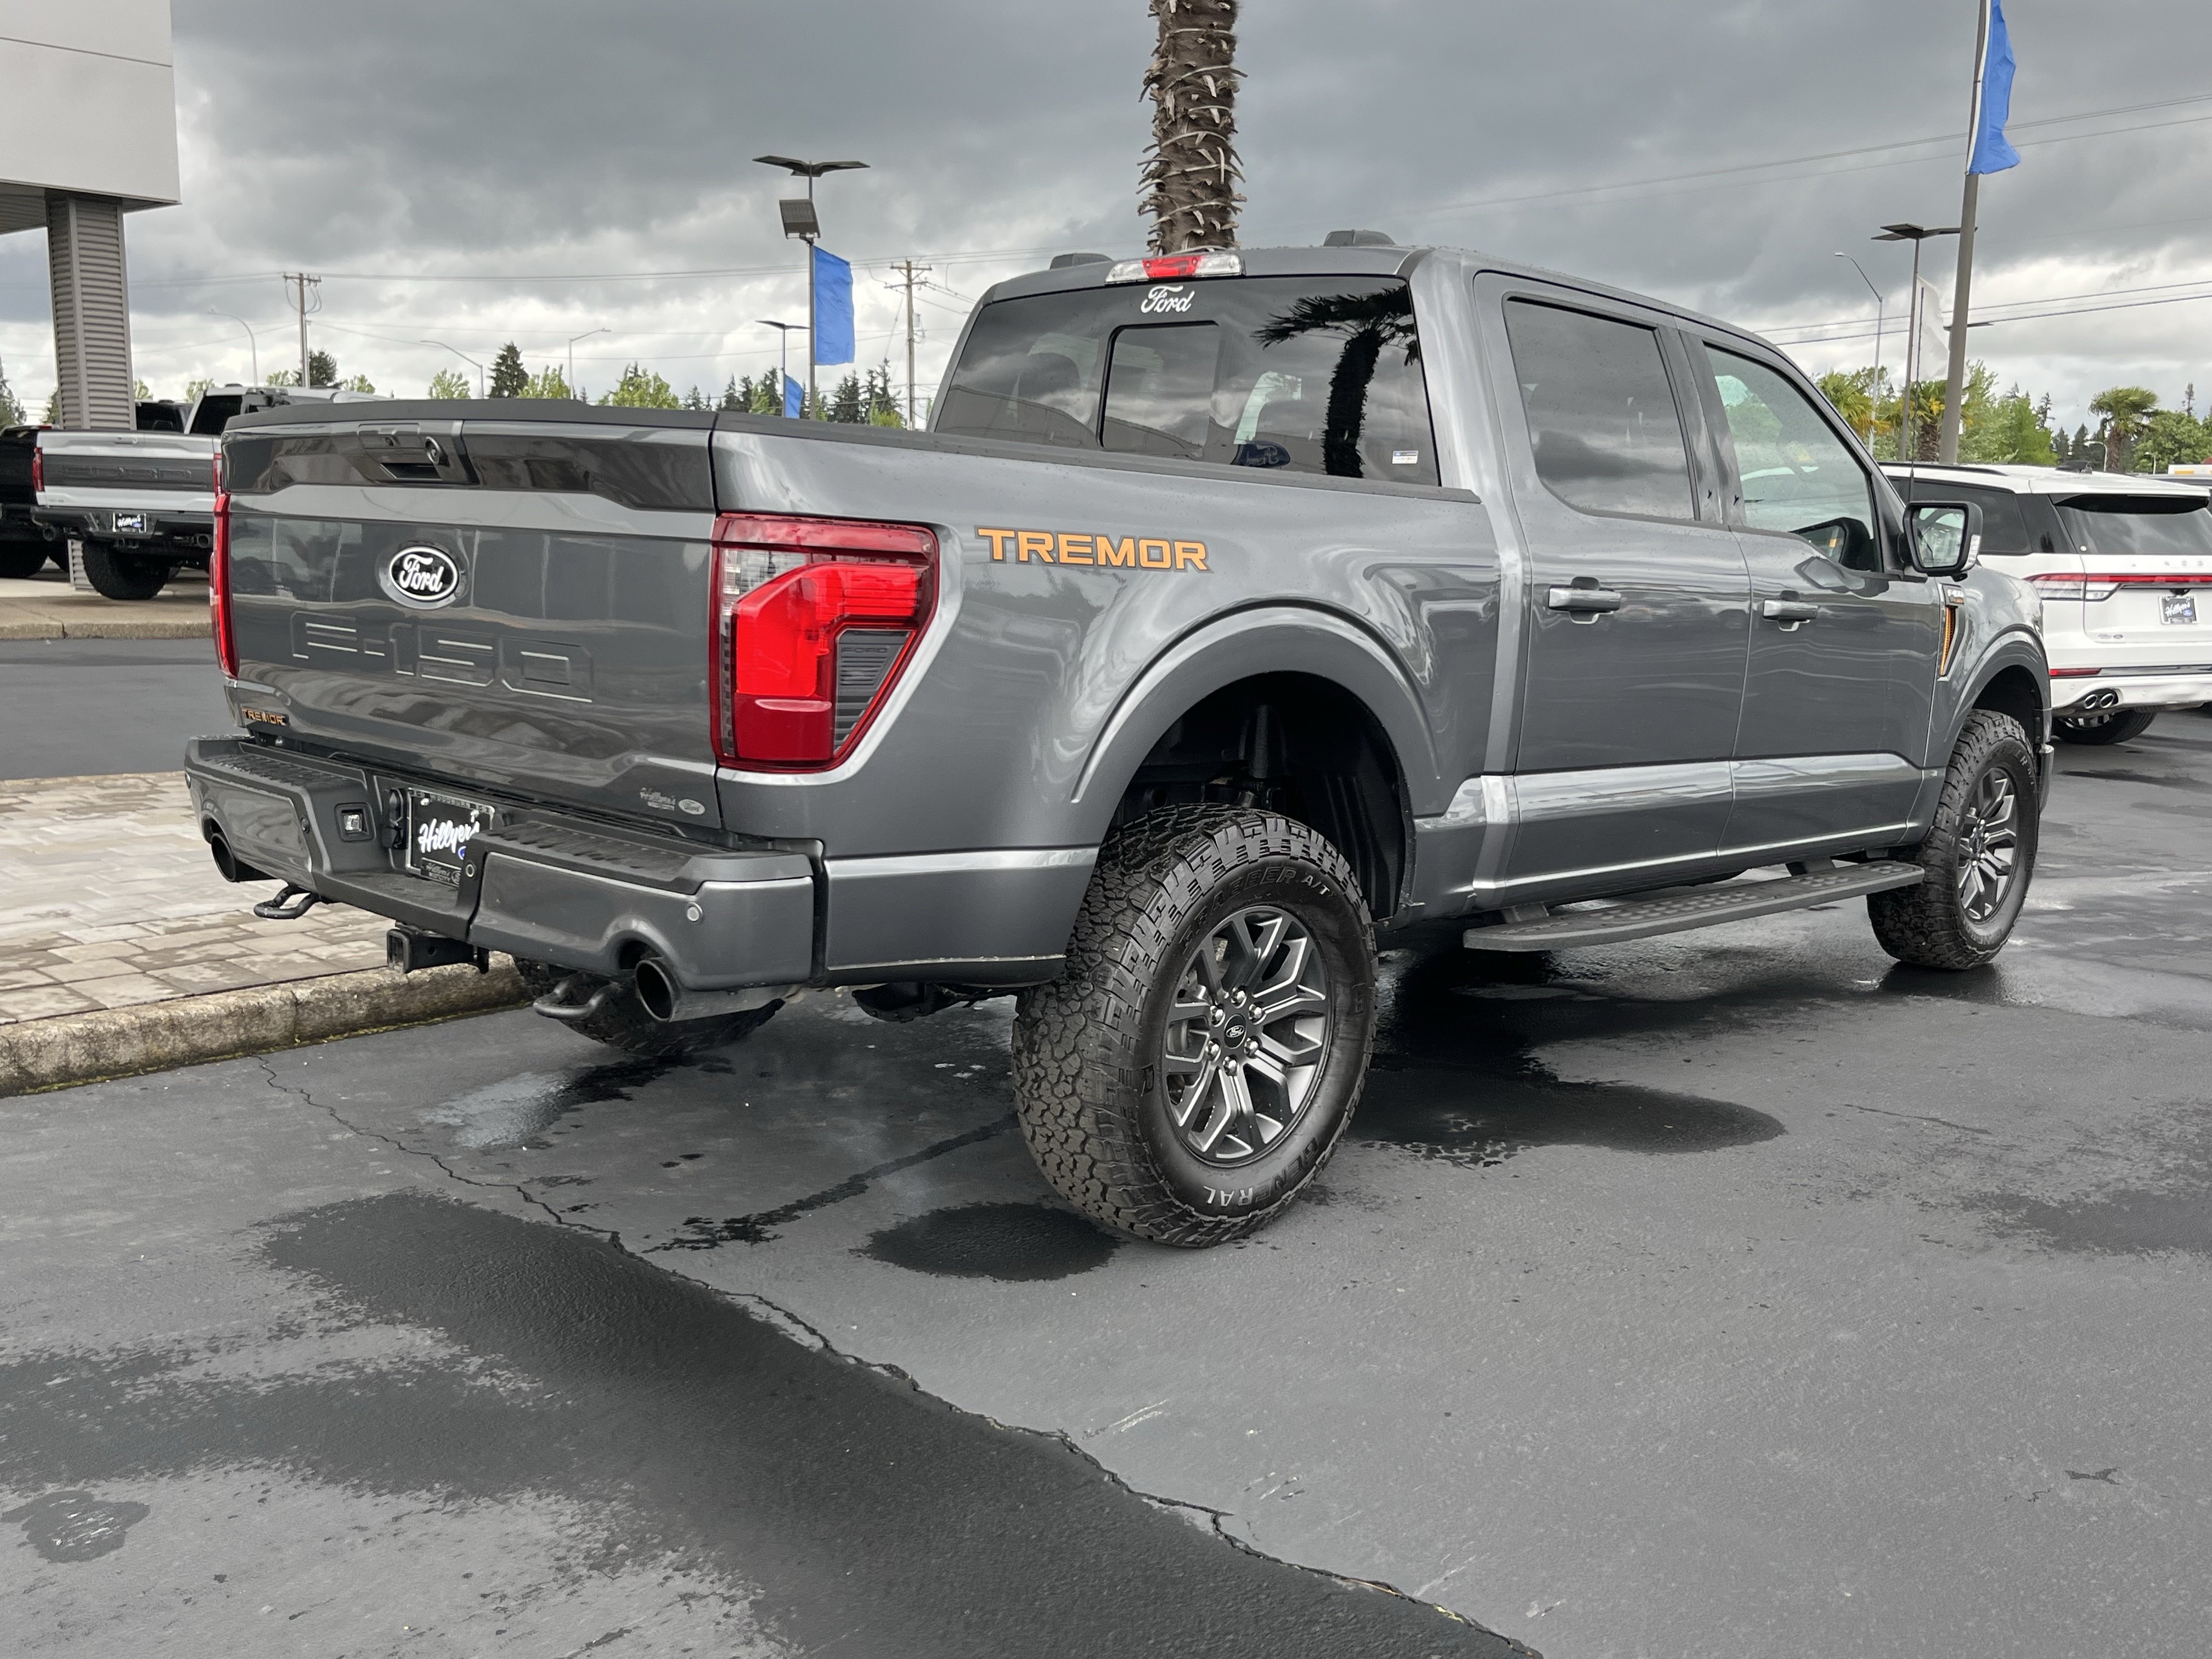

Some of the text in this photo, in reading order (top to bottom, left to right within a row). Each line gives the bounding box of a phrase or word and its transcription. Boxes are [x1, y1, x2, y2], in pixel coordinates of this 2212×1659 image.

[1141, 285, 1195, 313] Ford
[978, 527, 1208, 571] TREMOR
[399, 554, 444, 592] Ford
[290, 610, 593, 703] F-150
[241, 708, 286, 726] TREMOR
[1204, 1136, 1319, 1206] GENERAL
